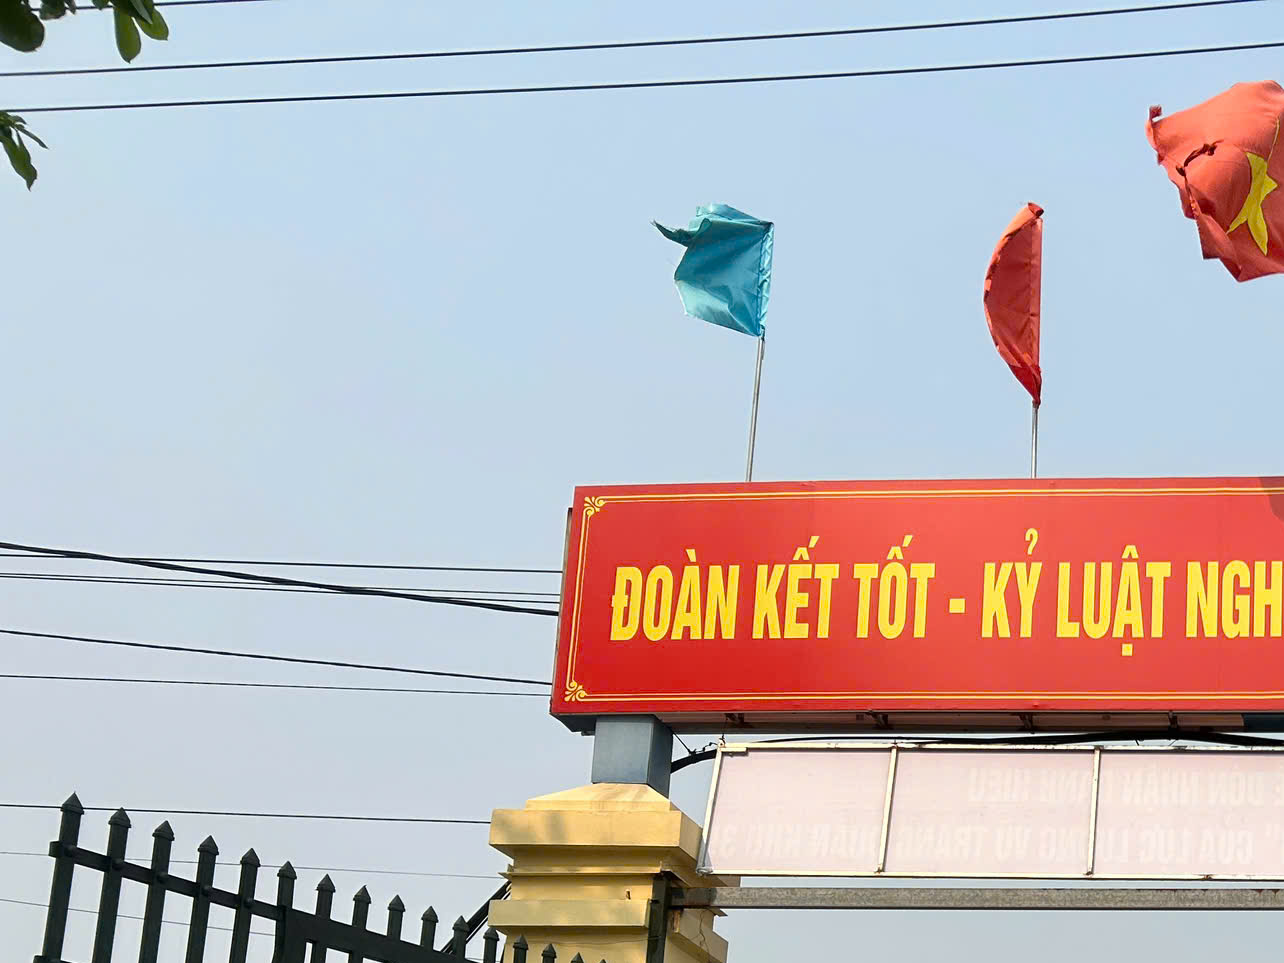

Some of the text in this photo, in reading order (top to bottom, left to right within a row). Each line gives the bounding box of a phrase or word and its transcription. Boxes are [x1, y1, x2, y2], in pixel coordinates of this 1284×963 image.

[611, 549, 740, 641] ĐOÀN
[752, 536, 840, 640] KẾT
[853, 536, 936, 639] TỐT
[982, 528, 1042, 639] KỶ
[1056, 546, 1171, 657] LUẬT
